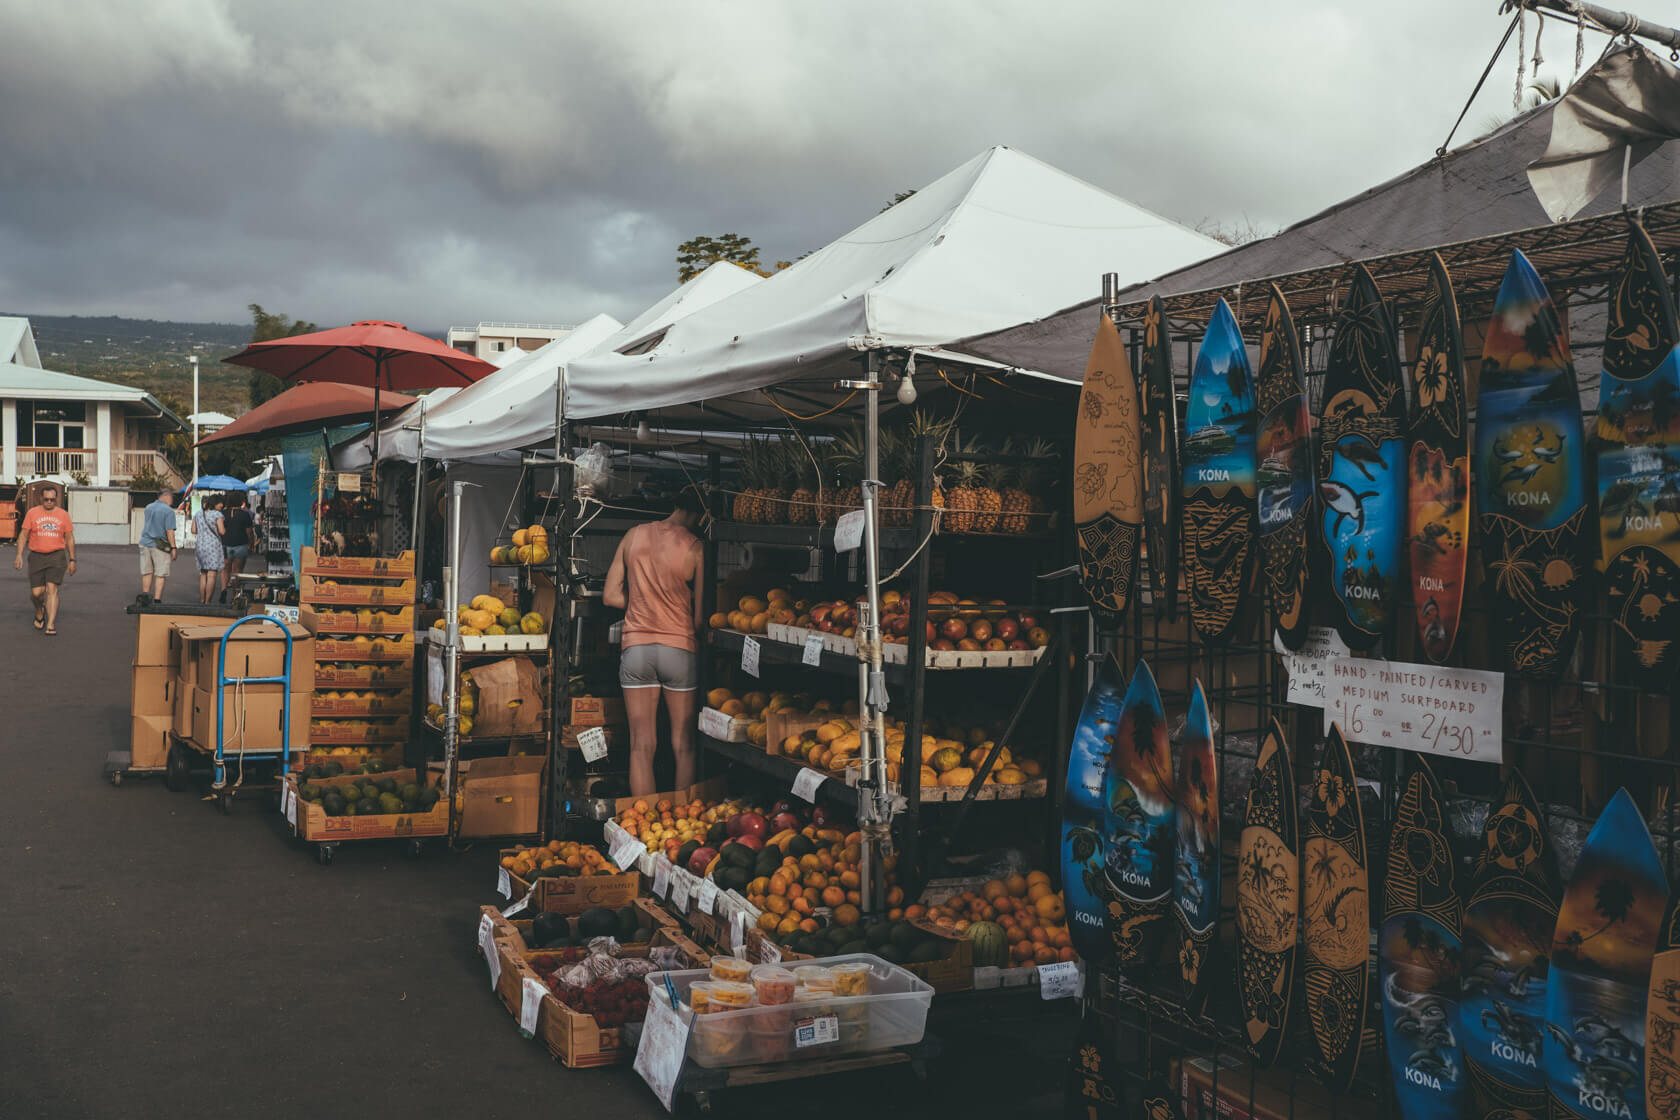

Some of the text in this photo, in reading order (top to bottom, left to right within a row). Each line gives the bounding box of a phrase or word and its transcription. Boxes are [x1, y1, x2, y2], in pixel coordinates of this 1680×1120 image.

[1198, 469, 1230, 481] KONA
[1507, 490, 1551, 506] KONA
[1270, 507, 1293, 522] KONA
[1625, 516, 1662, 531] KONA
[1419, 576, 1444, 592] KONA
[1345, 585, 1381, 601] KONA
[1342, 685, 1390, 703] MEDIUM
[575, 699, 600, 712] Dole
[1400, 693, 1476, 714] SURFBOARD
[325, 818, 352, 830] Dole
[547, 880, 577, 893] Dole
[1122, 872, 1151, 888] KONA
[1181, 896, 1198, 916] KONA
[1075, 911, 1104, 928] KONA
[1491, 1041, 1536, 1068] KONA
[1405, 1066, 1442, 1091] KONA
[1579, 1091, 1633, 1120] KONA
